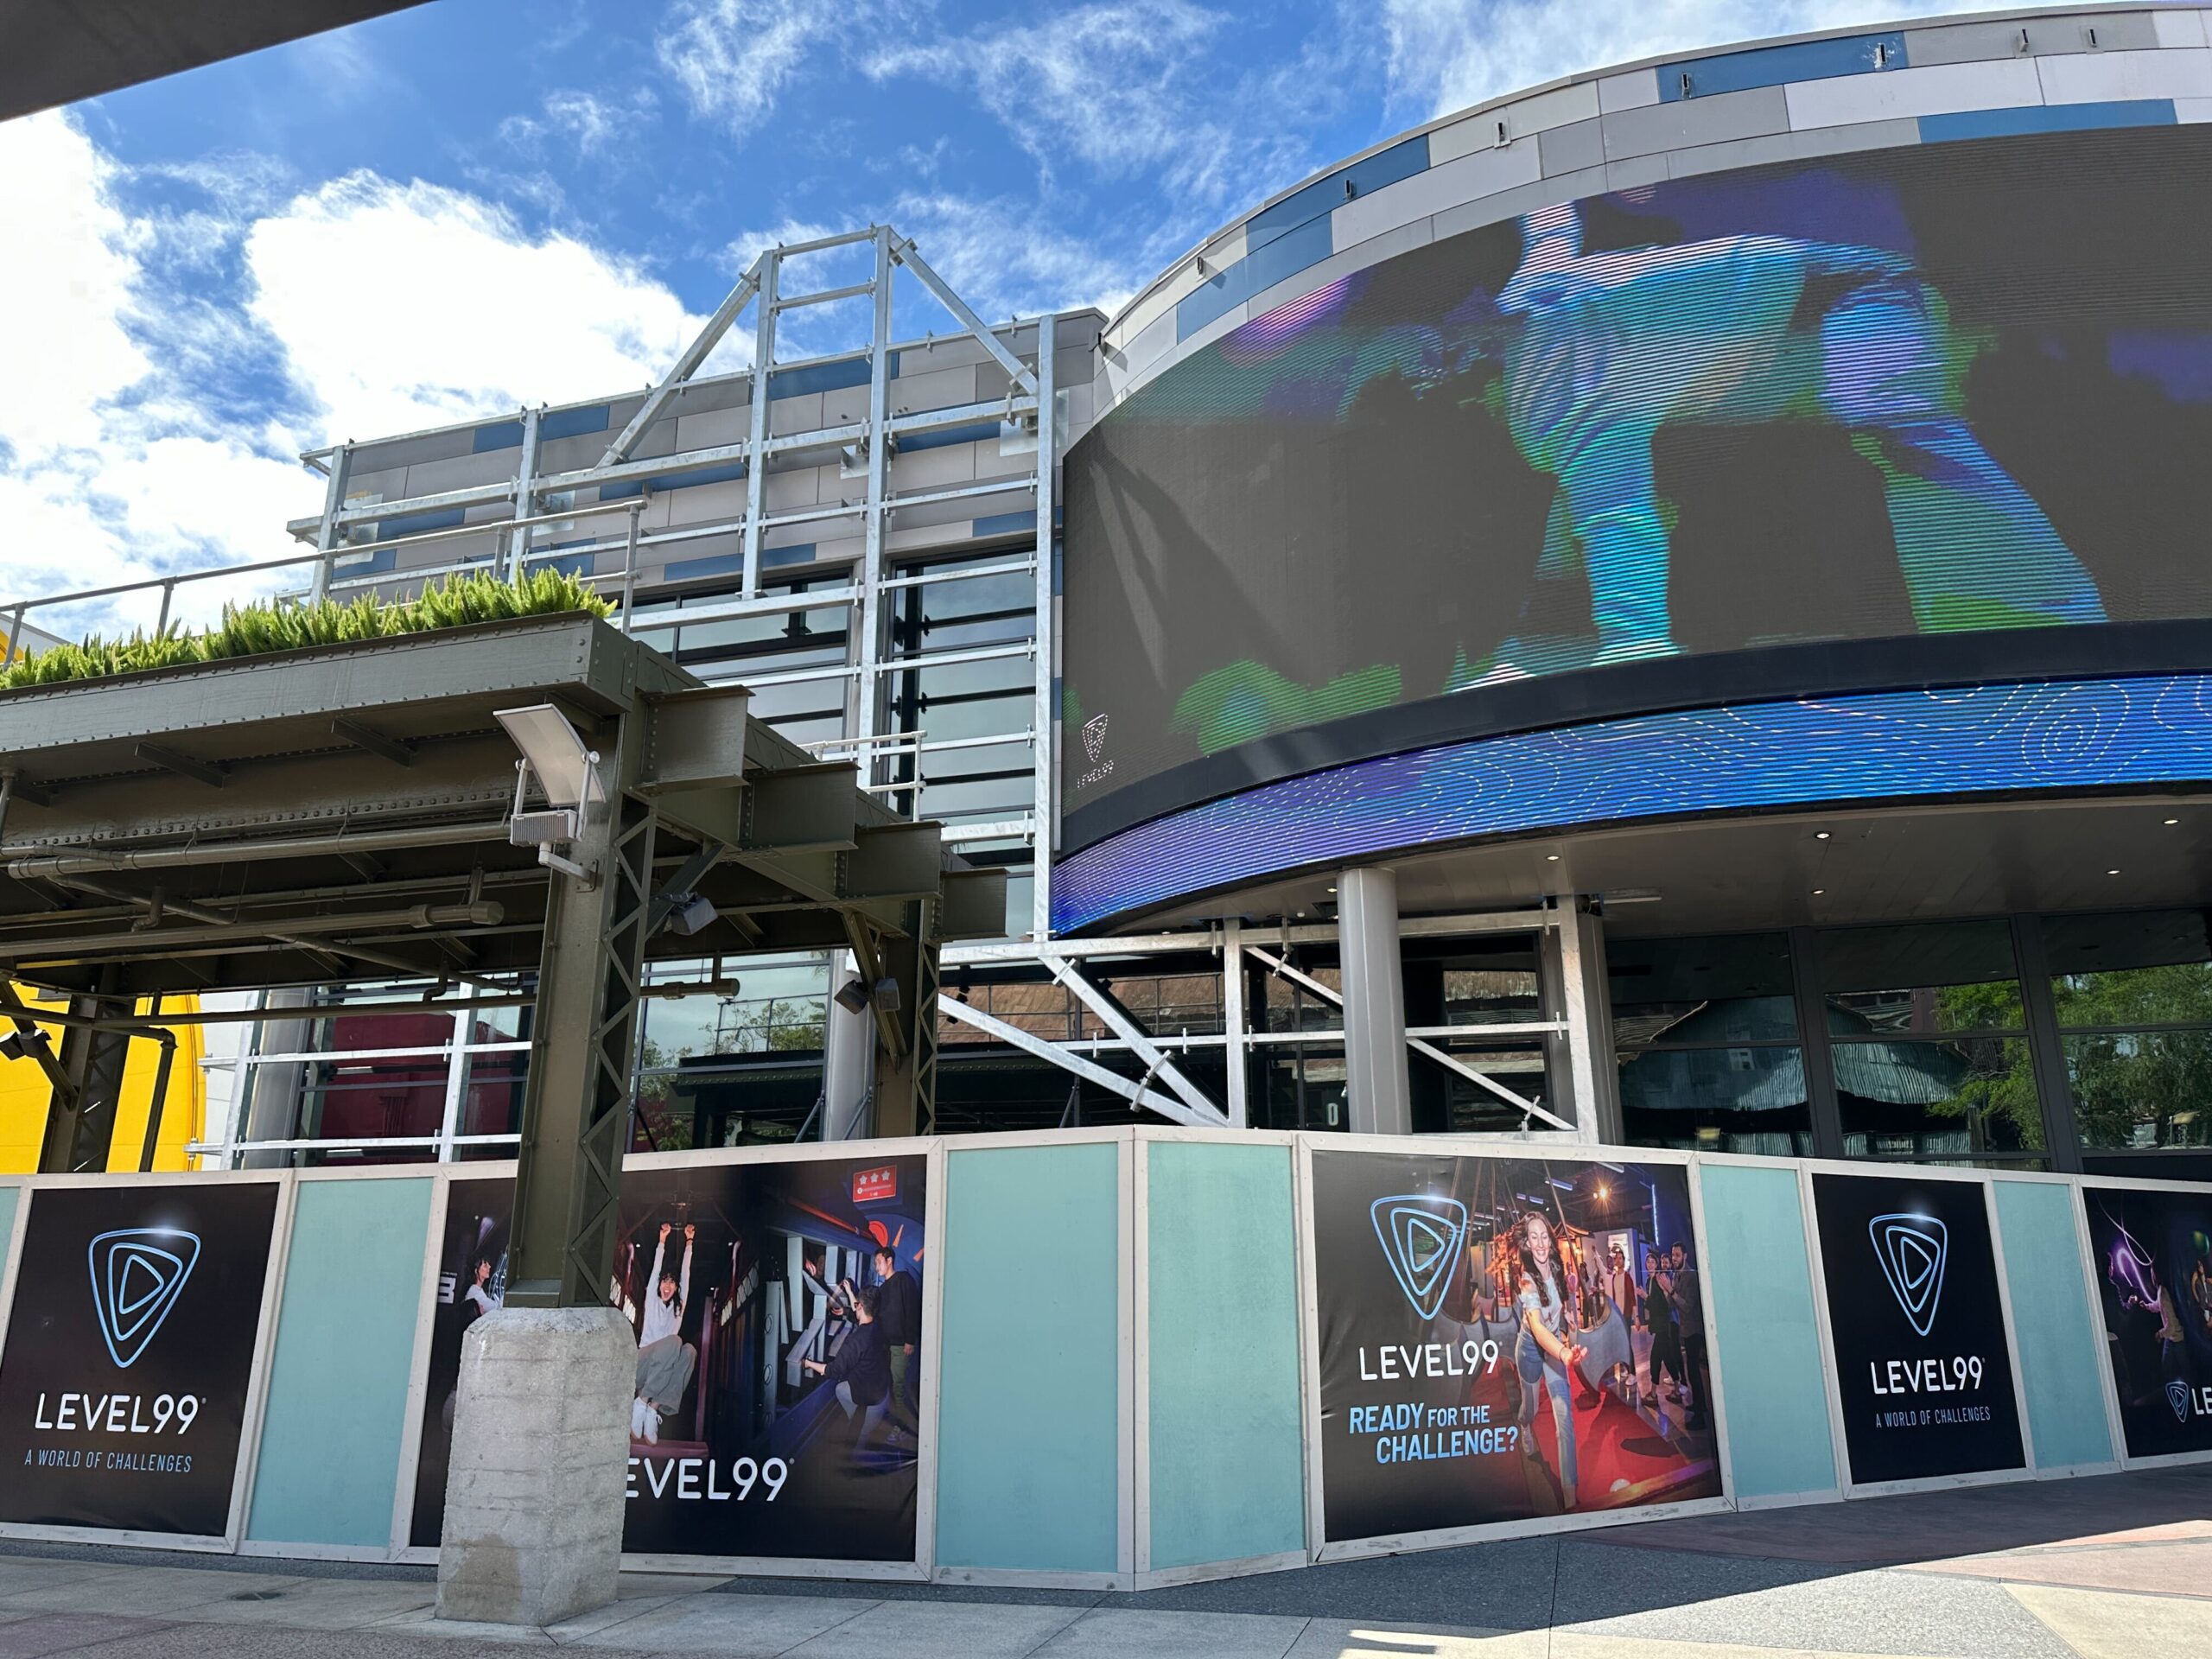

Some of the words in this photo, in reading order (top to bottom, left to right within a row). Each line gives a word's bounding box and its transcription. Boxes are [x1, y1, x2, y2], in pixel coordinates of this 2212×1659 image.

[1359, 1339, 1499, 1381] LEVEL99
[1871, 1356, 1983, 1395] LEVEL99
[35, 1393, 199, 1434] LEVEL99
[1349, 1402, 1425, 1434] READY
[1427, 1408, 1458, 1427] FOR
[1460, 1405, 1491, 1425] THE
[1876, 1414, 1882, 1428] A
[1885, 1411, 1916, 1428] WORLD
[1920, 1410, 1931, 1425] OF
[1935, 1406, 1991, 1425] CHALLENGES
[24, 1449, 32, 1465] A
[38, 1449, 81, 1468] WORLD
[86, 1451, 103, 1469] OF
[107, 1452, 192, 1473] CHALLENGES
[1376, 1426, 1519, 1465] CHALLENGE?
